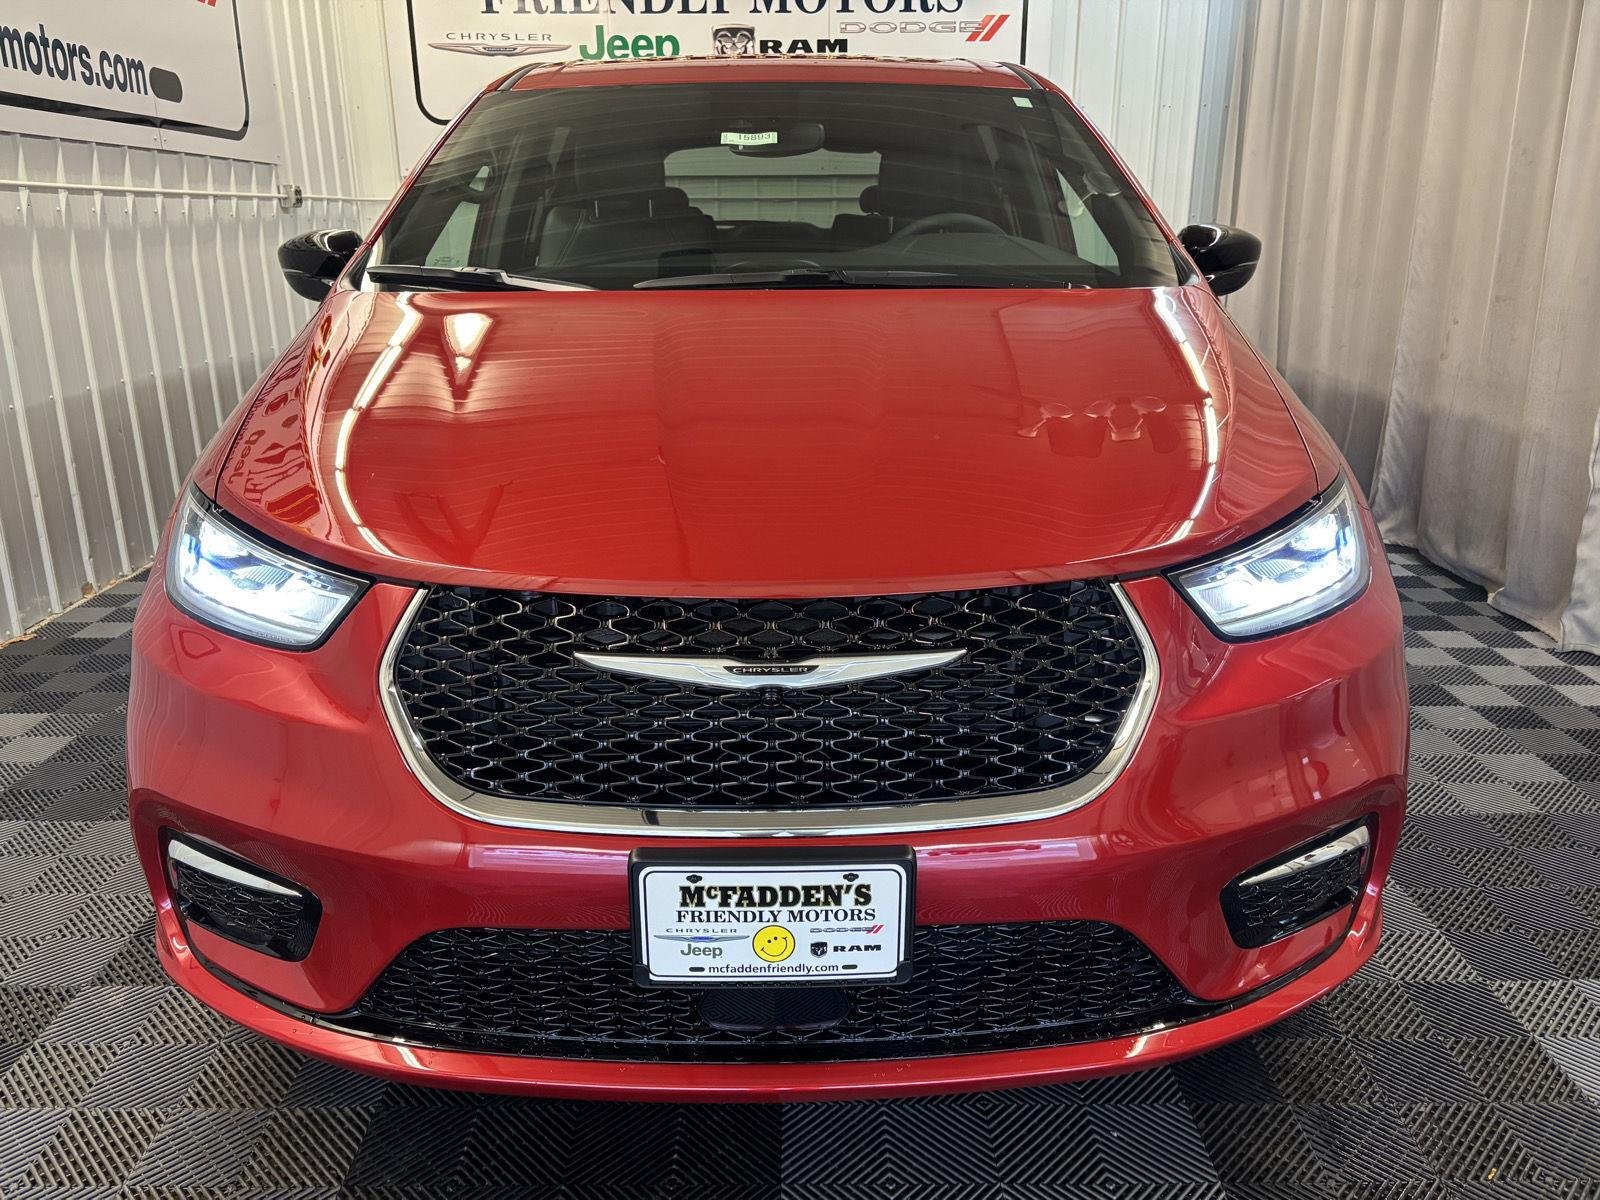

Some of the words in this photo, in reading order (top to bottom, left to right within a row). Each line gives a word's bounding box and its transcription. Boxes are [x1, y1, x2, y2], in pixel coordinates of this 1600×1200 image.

[839, 21, 985, 34] DODGE
[446, 32, 552, 41] CHRYSLER
[759, 39, 848, 54] RAM
[676, 910, 781, 923] FRIENDLY
[787, 908, 876, 922] MOTORS
[680, 943, 723, 959] Jeep
[833, 944, 882, 952] RAM
[708, 964, 839, 974] mcfaddenfriendly.com
